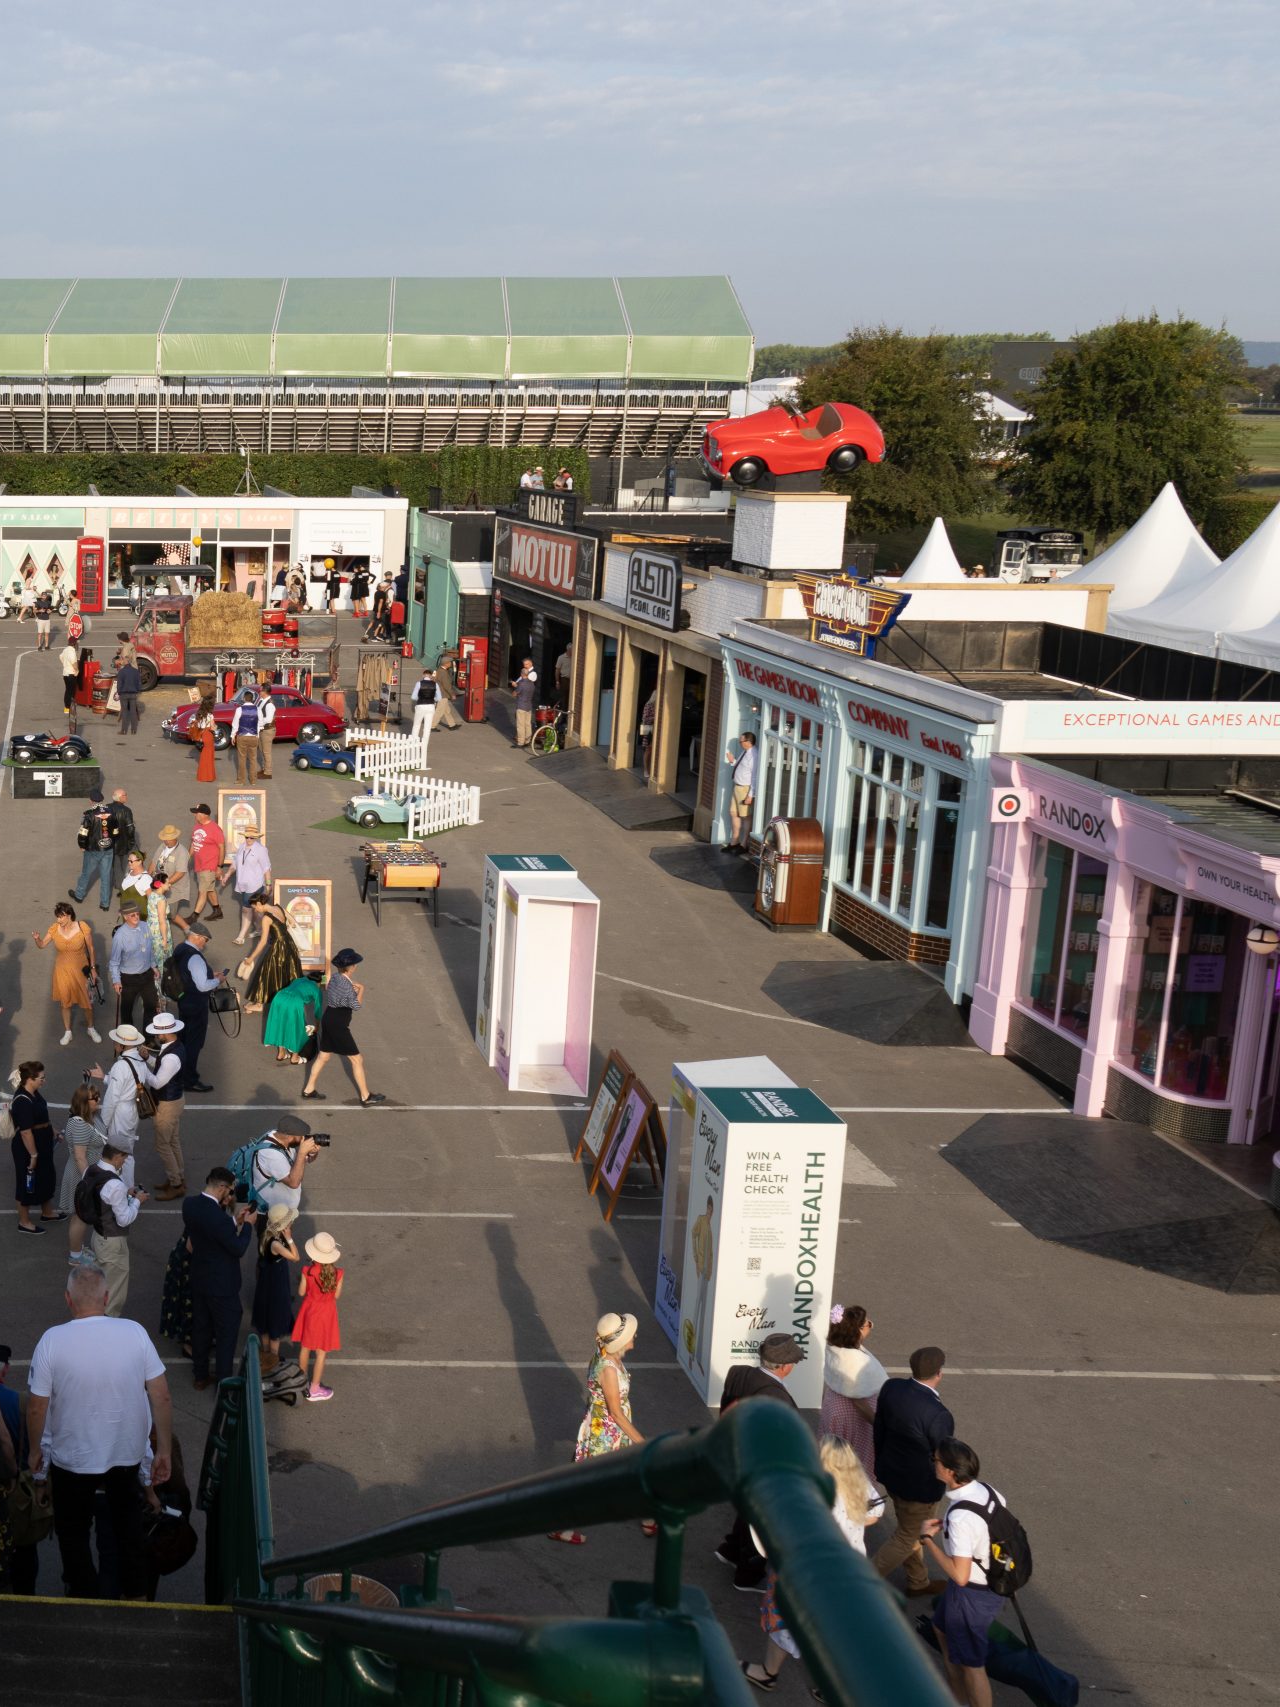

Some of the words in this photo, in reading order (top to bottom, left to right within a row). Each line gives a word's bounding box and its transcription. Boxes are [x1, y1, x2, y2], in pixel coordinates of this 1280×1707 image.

[20, 513, 59, 521] SALON
[528, 494, 564, 525] GARAGE
[114, 512, 234, 526] BETTY'S
[248, 514, 287, 522] SALON
[510, 534, 574, 591] MOTUL
[631, 557, 673, 604] AUSTIN
[630, 597, 650, 616] PEDAL
[653, 603, 670, 621] CARS
[70, 622, 82, 630] STOP
[733, 657, 752, 678] THE
[753, 665, 787, 694] GAMES
[786, 677, 820, 707] ROOM
[847, 700, 910, 740] COMPANY
[1063, 712, 1181, 727] EXCEPTIONAL
[1187, 712, 1243, 727] GAMES
[1038, 794, 1107, 843] RANDOX
[1197, 866, 1218, 882] OWN
[1218, 871, 1242, 894] YOUR
[747, 1151, 770, 1161] WIN
[773, 1151, 782, 1161] A
[745, 1162, 772, 1172] FREE
[745, 1174, 789, 1183] HEALTH
[744, 1185, 784, 1195] CHECK
[735, 1303, 768, 1318] Every
[748, 1316, 776, 1331] Man
[731, 1340, 765, 1348] RAND
